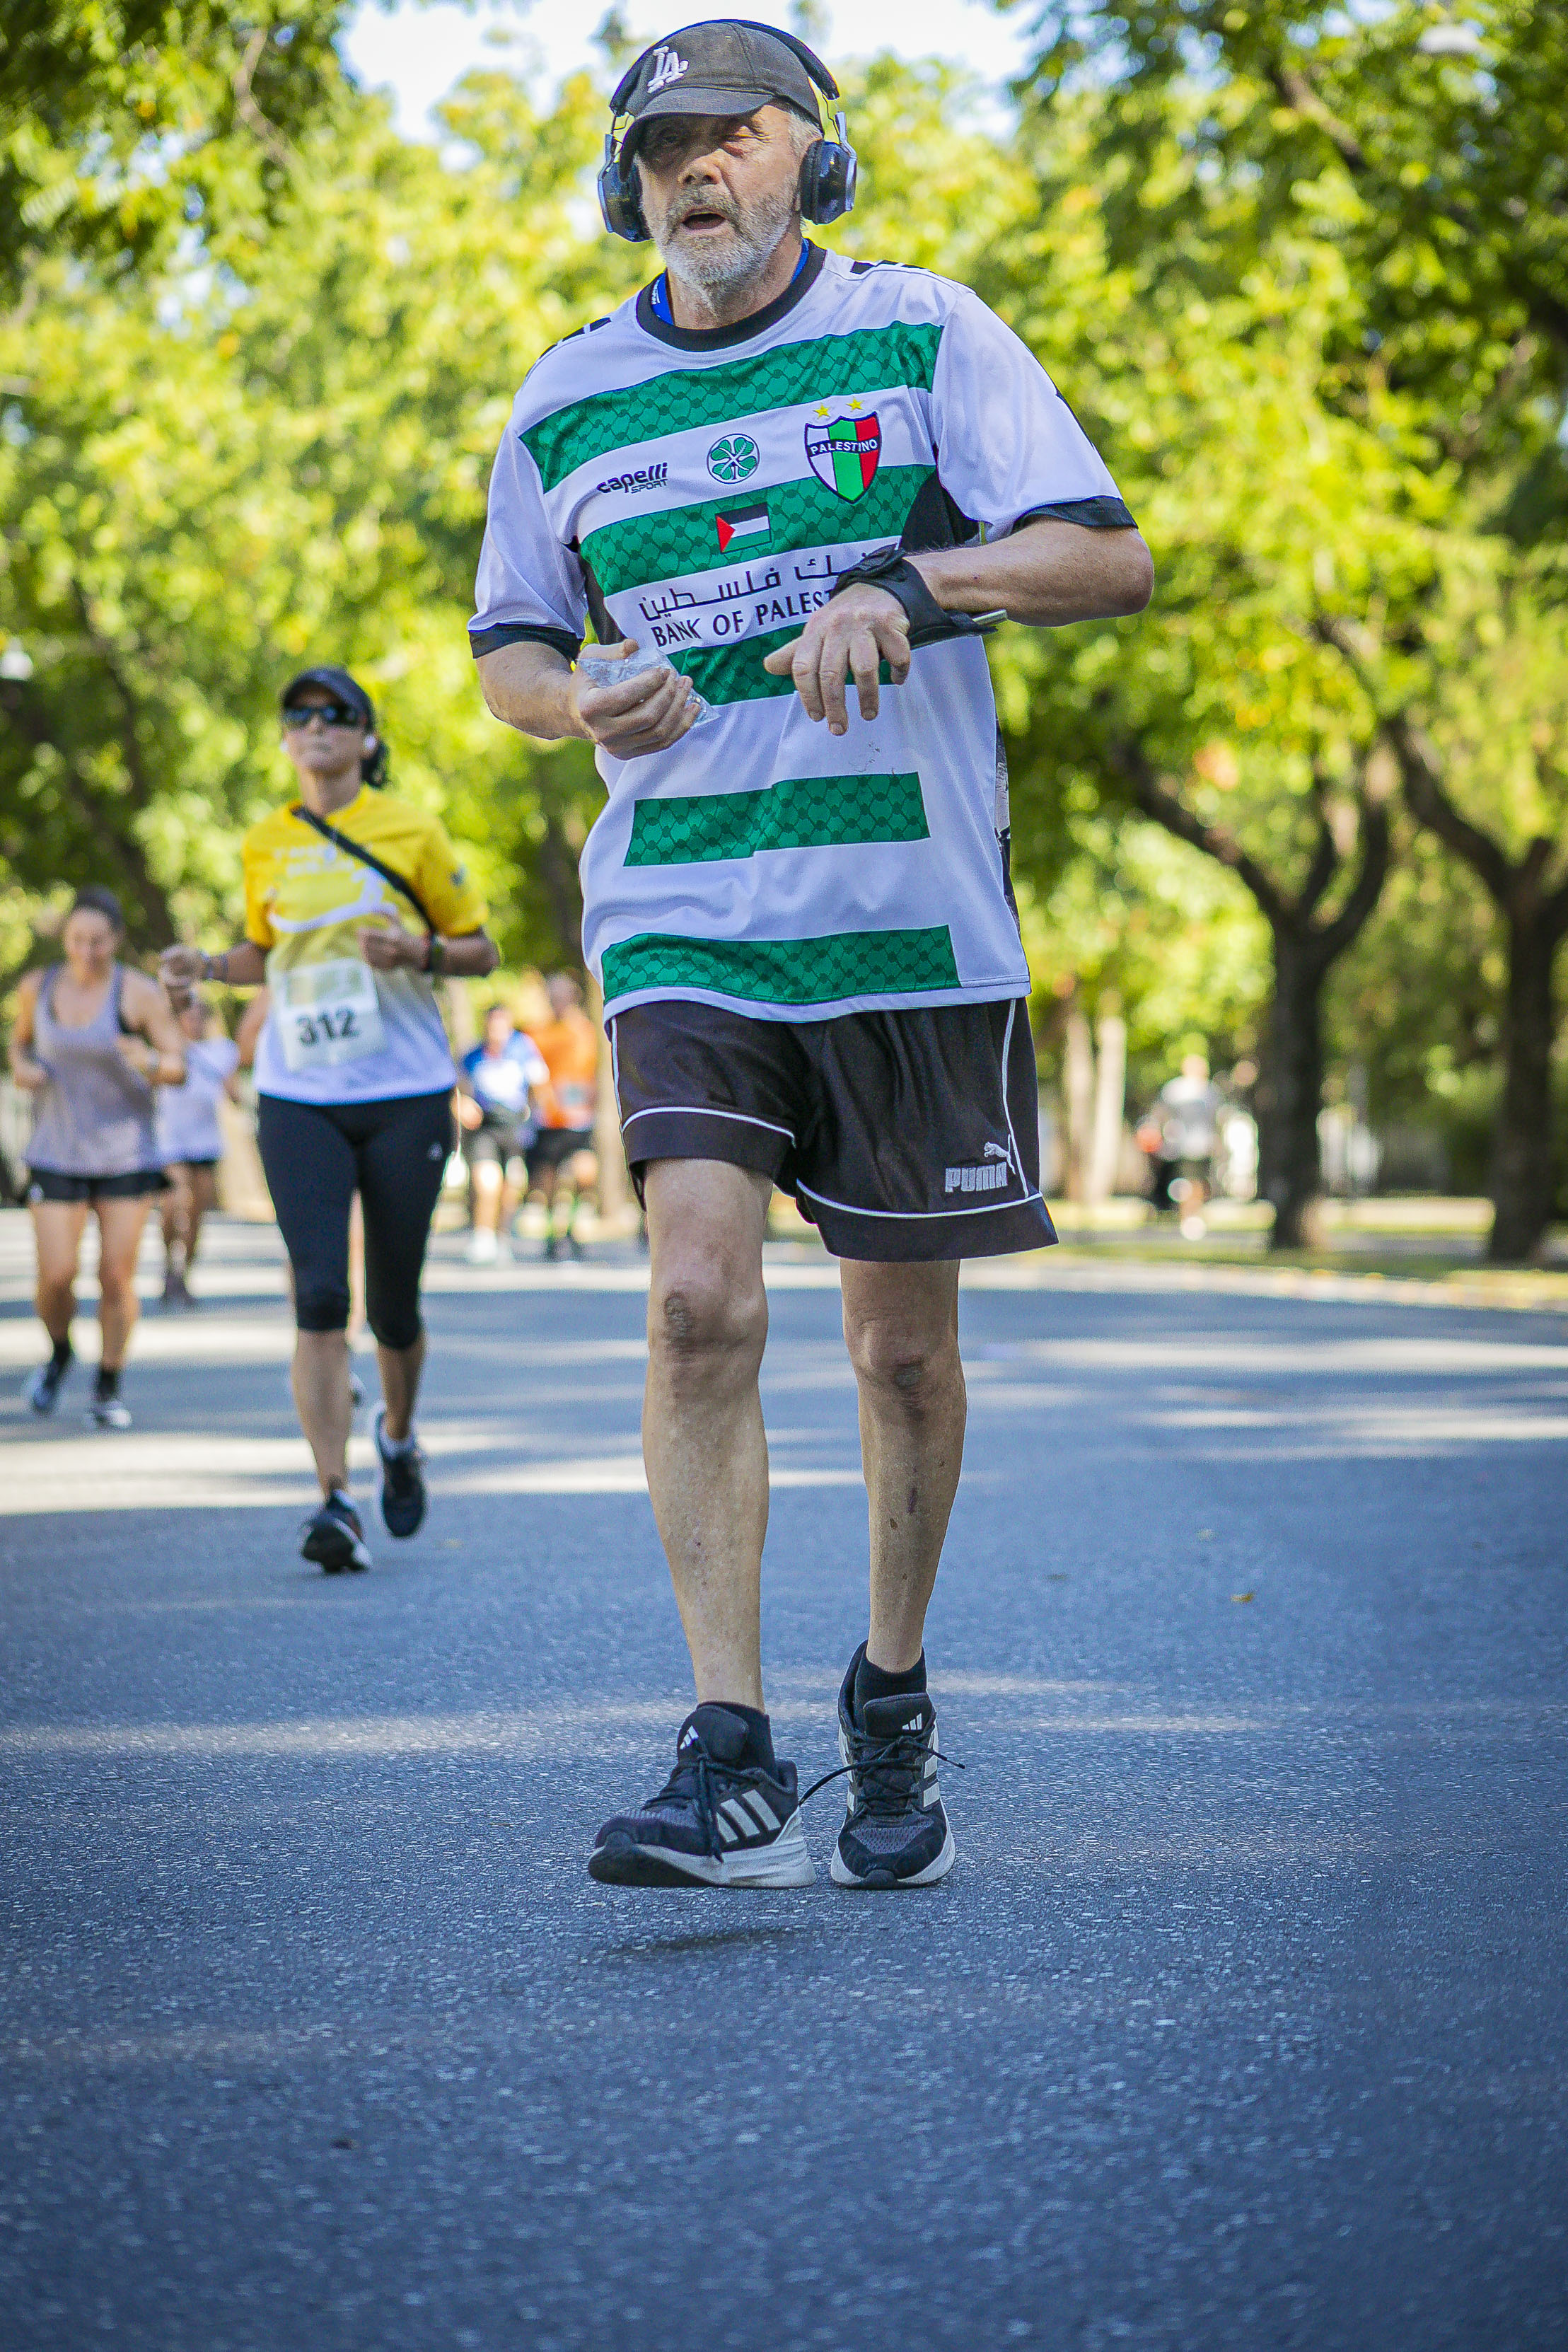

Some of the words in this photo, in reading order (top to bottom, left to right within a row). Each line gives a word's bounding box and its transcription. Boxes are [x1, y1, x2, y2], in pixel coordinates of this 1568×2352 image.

[646, 45, 689, 93] LA
[809, 439, 878, 455] PALESTINO
[597, 462, 668, 493] capelli
[631, 478, 668, 494] SPORT
[639, 567, 782, 618] فلسطين
[651, 618, 701, 647] BANK
[713, 610, 745, 636] OF
[296, 1007, 359, 1047] 312
[945, 1161, 1008, 1193] PUMA
